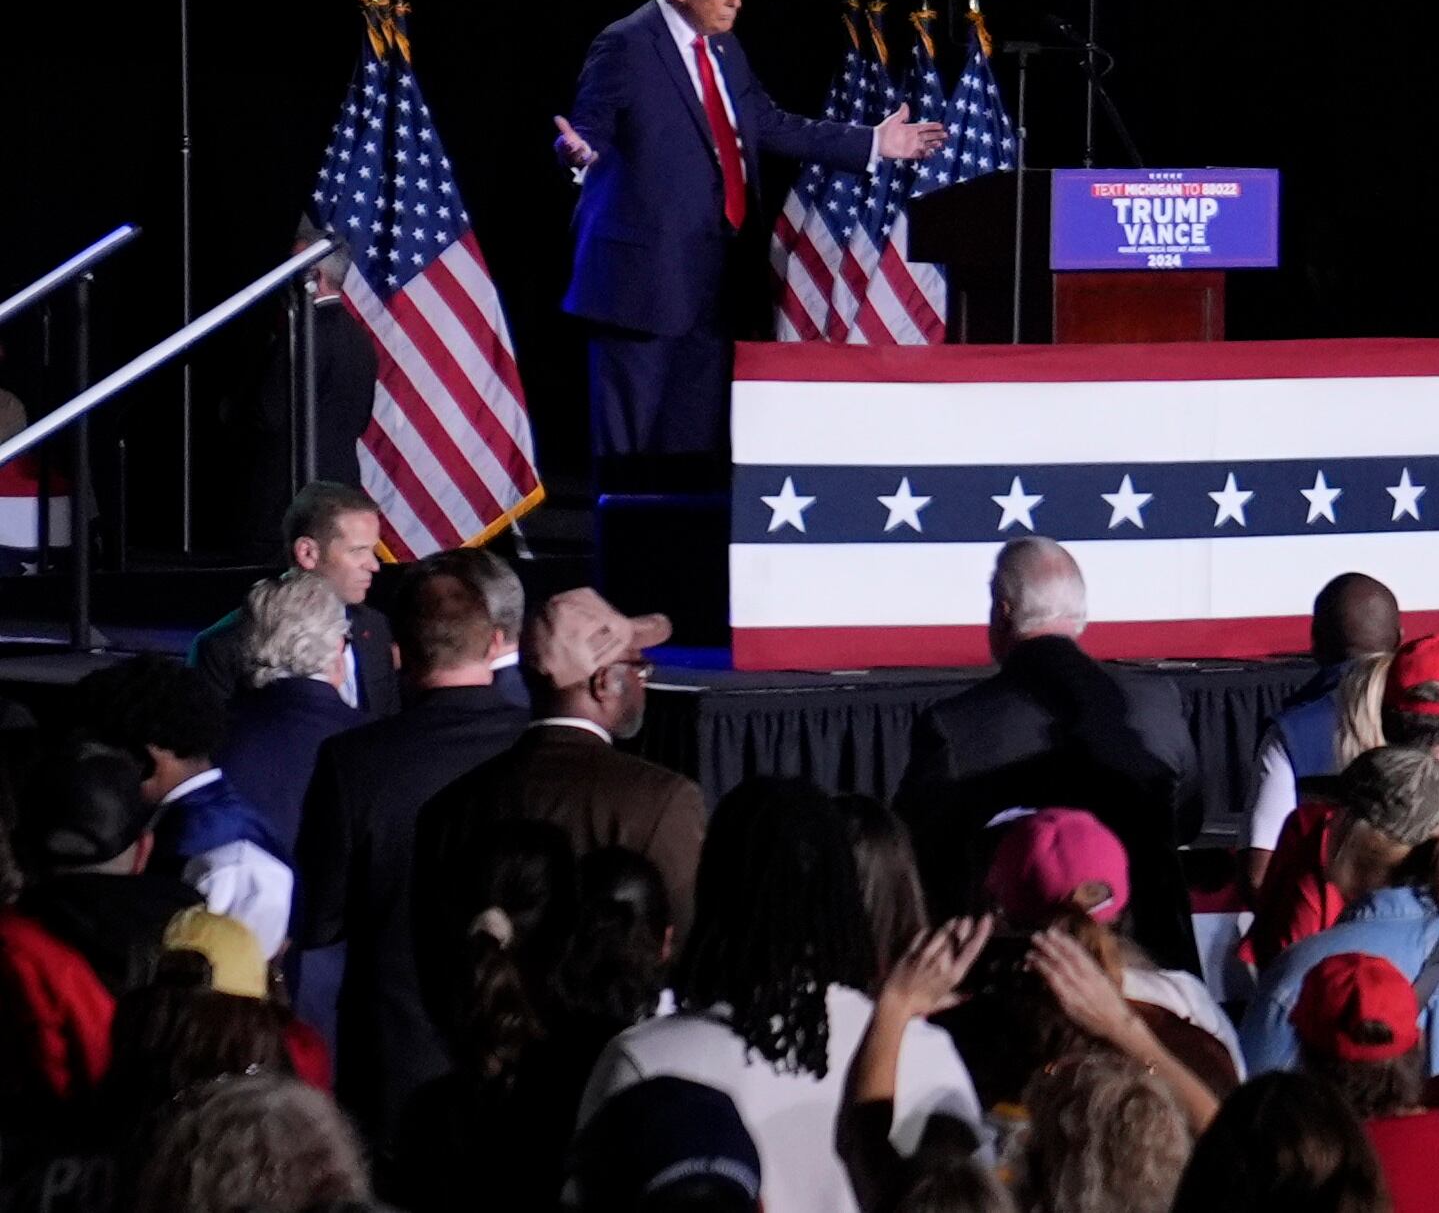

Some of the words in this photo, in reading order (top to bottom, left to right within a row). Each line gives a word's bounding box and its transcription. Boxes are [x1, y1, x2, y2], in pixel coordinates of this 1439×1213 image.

[1094, 184, 1123, 197] TEXT
[1125, 184, 1182, 197] MICHIGAN
[1184, 184, 1200, 197] TO
[1112, 197, 1219, 224] TRUMP
[1123, 224, 1206, 245] VANCE
[1147, 254, 1182, 267] 2024
